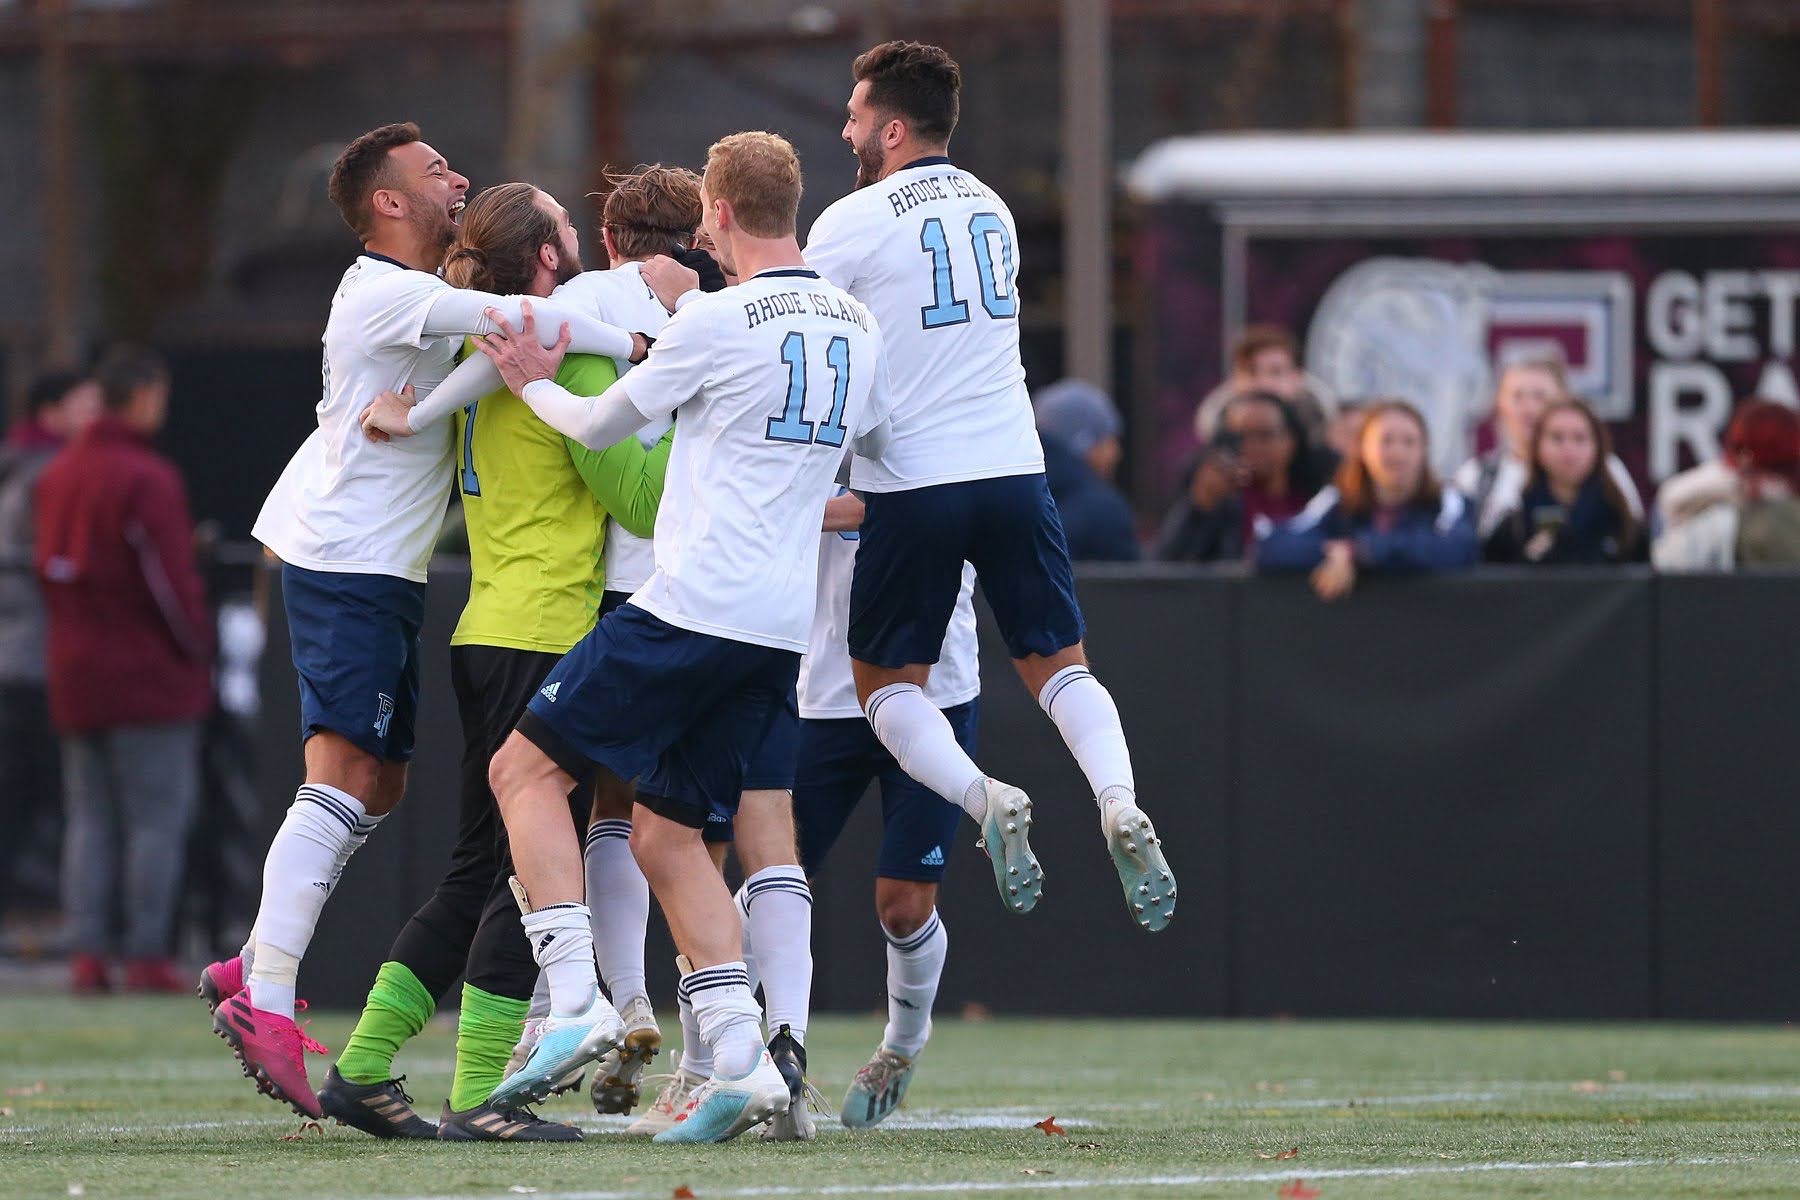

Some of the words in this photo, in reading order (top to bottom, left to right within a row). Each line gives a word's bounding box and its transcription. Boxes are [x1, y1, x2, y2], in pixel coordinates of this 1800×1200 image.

[888, 176, 947, 218] RHODE
[743, 291, 807, 330] RHODE
[807, 292, 869, 334] ISLAND
[920, 211, 1018, 330] 10
[1645, 270, 1800, 360] GET
[764, 331, 851, 449] 11
